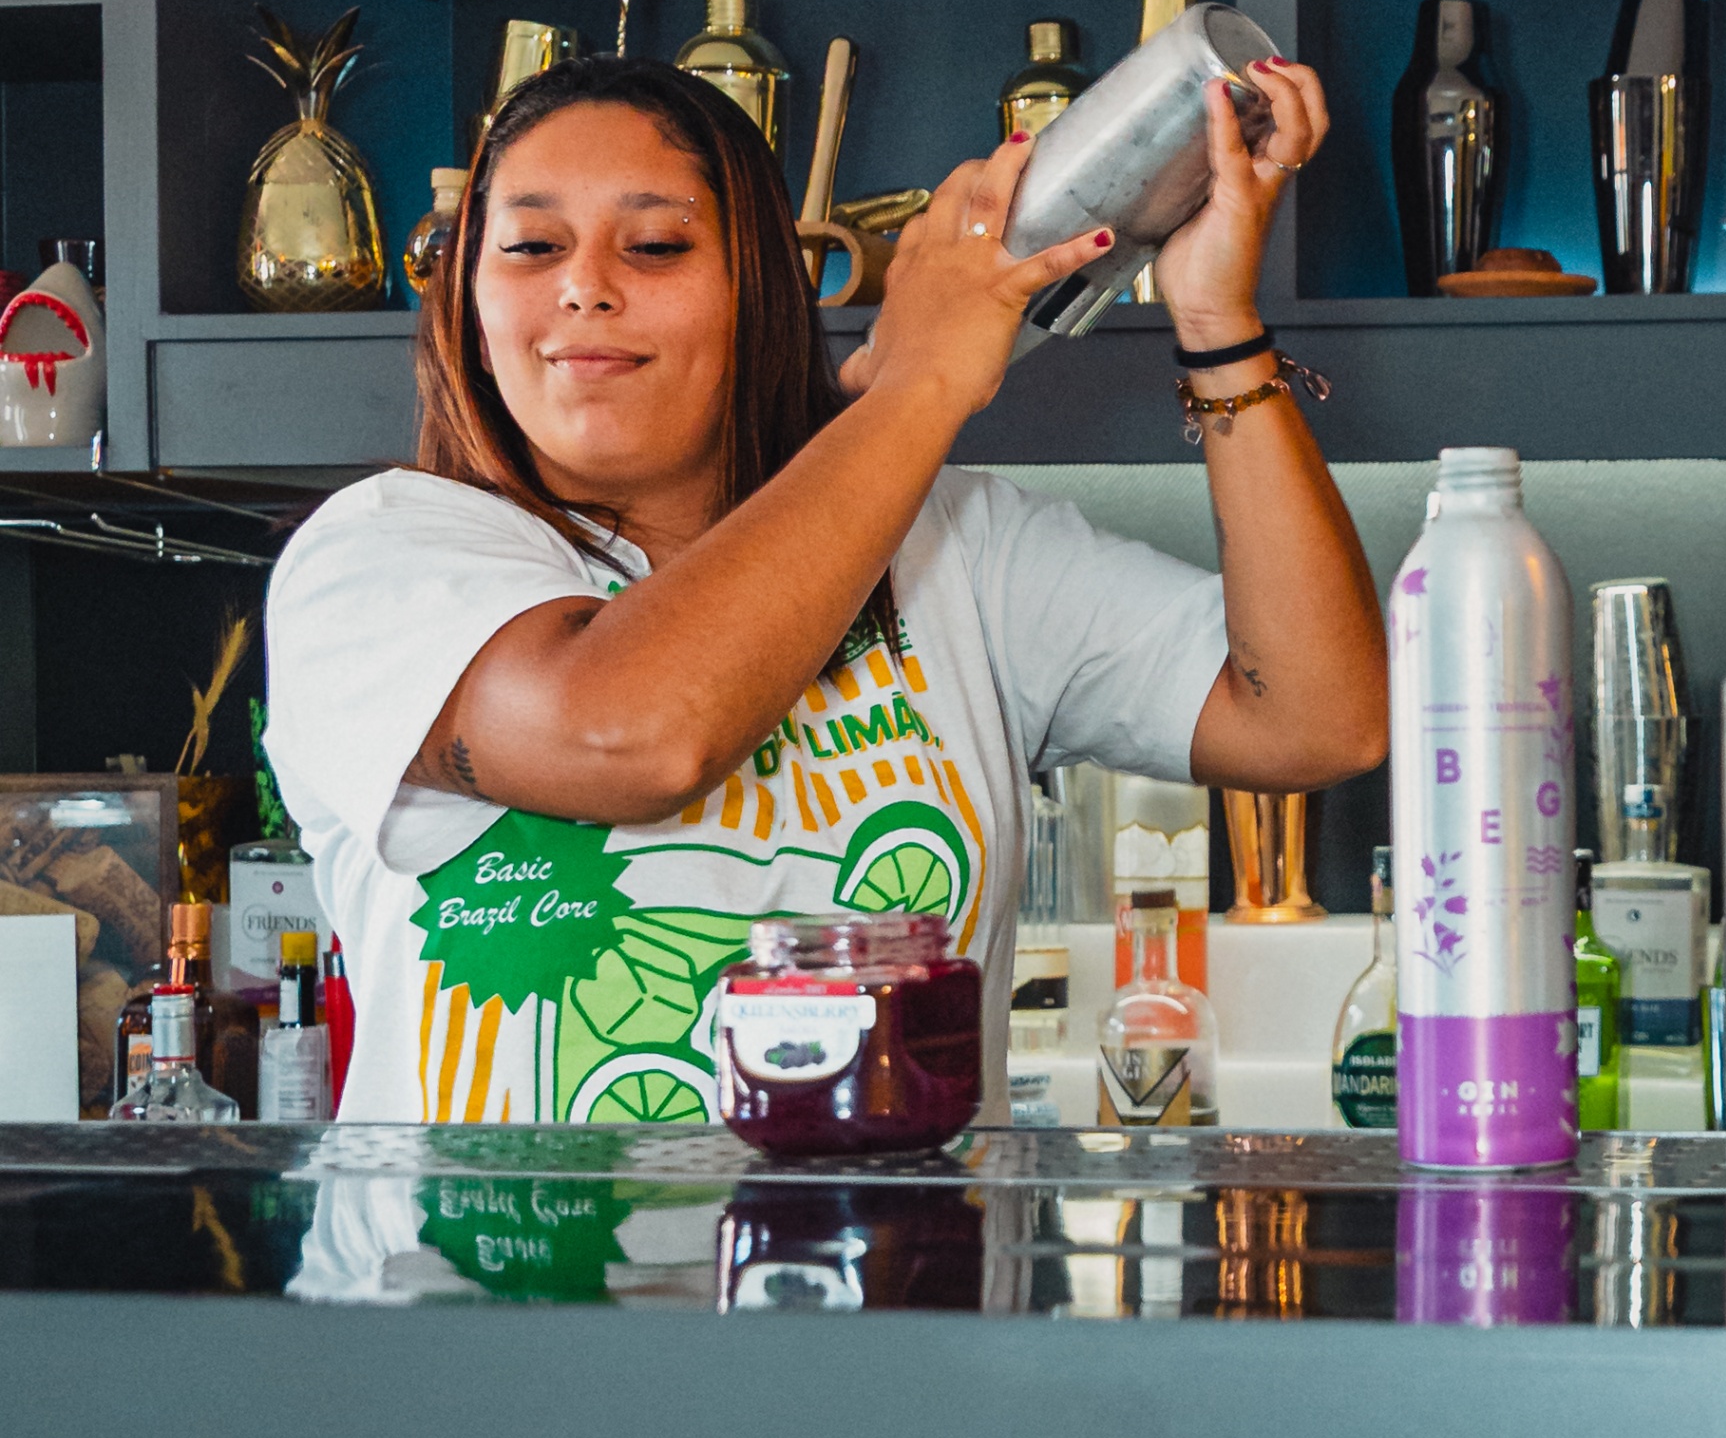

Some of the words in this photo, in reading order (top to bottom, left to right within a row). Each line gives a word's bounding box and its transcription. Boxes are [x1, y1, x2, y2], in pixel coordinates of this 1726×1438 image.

[802, 691, 940, 758] LIMÃ
[475, 851, 553, 884] Basic
[247, 913, 317, 931] FRIENDS
[438, 895, 522, 935] Brazil
[530, 889, 598, 927] Core
[1458, 1080, 1519, 1101] GIN
